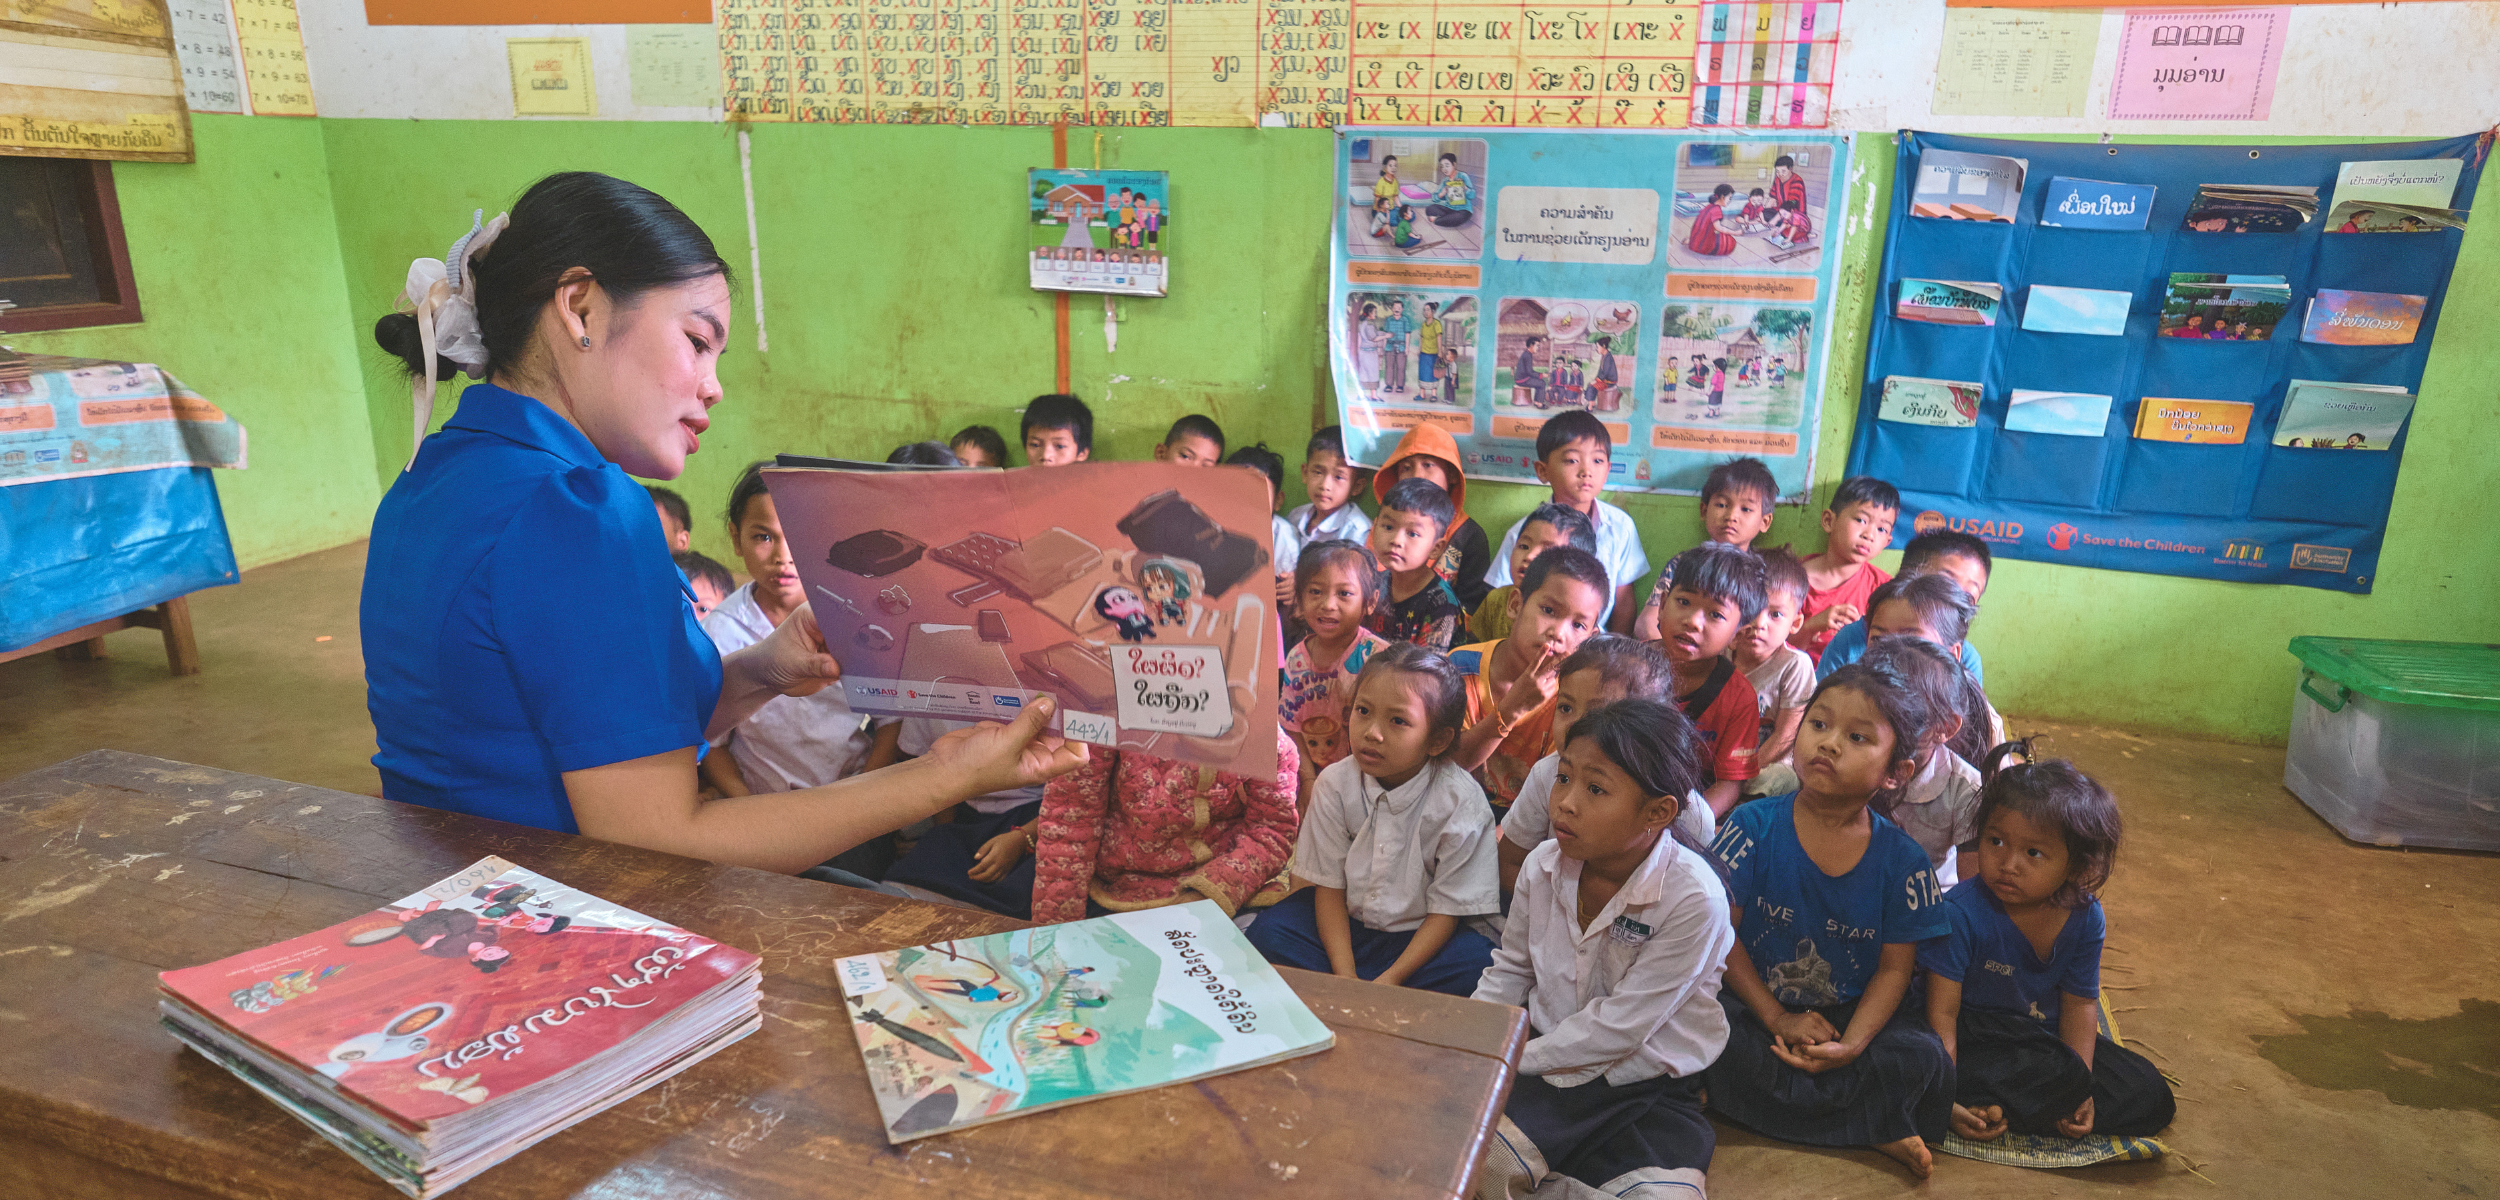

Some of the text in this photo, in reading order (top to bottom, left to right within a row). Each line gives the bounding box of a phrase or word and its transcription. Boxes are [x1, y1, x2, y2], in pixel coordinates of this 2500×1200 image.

[212, 14, 226, 24] 42
[2153, 56, 2225, 92] ມຸມອ່ານ
[1482, 454, 1512, 464] USAID
[1949, 517, 2023, 538] USAID
[2083, 534, 2205, 554] Save the Children
[868, 686, 898, 698] USAID
[1066, 720, 1109, 743] 443/1
[1757, 896, 1794, 922] FIVE
[1826, 918, 1876, 940] STAR
